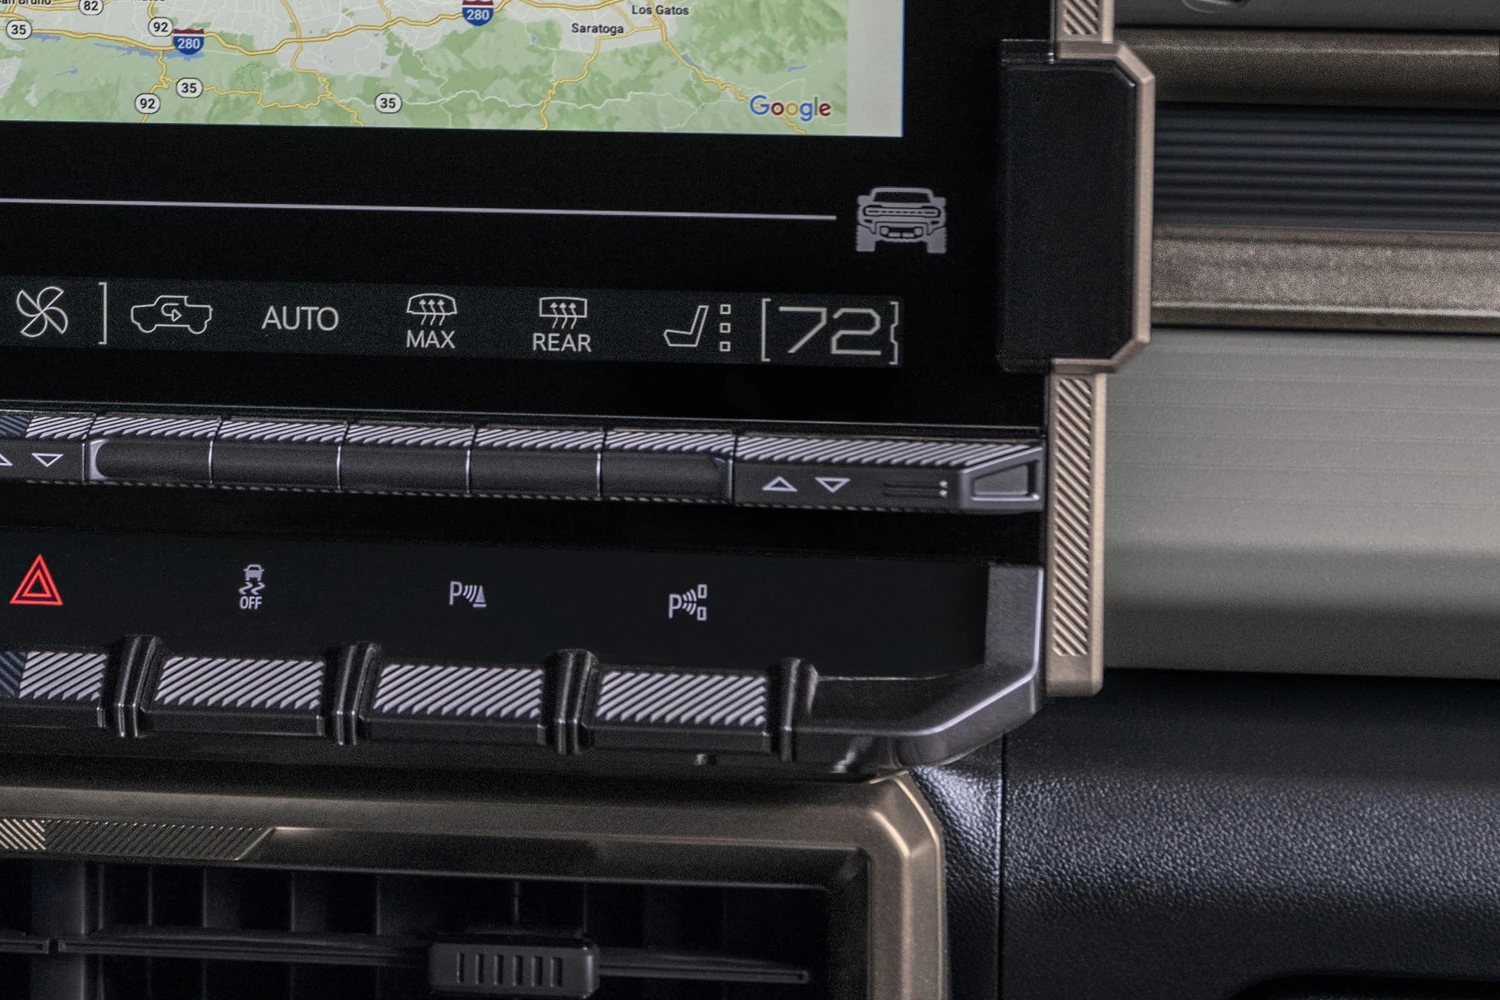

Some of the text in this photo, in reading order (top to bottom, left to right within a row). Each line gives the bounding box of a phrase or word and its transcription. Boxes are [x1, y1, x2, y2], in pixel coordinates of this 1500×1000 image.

[84, 1, 98, 11] 82
[632, 6, 689, 16] Los Gatos
[467, 10, 489, 20] 280
[11, 25, 26, 35] 35
[153, 22, 168, 32] 92
[571, 24, 624, 36] Saratoga
[178, 38, 200, 49] 280
[182, 83, 197, 94] 35
[140, 99, 155, 109] 92
[381, 98, 395, 108] 35
[749, 95, 831, 121] Google
[262, 307, 339, 331] AUTO
[779, 306, 882, 355] 72
[407, 330, 455, 349] MAX
[532, 332, 592, 352] REAR
[239, 597, 262, 610] OFF
